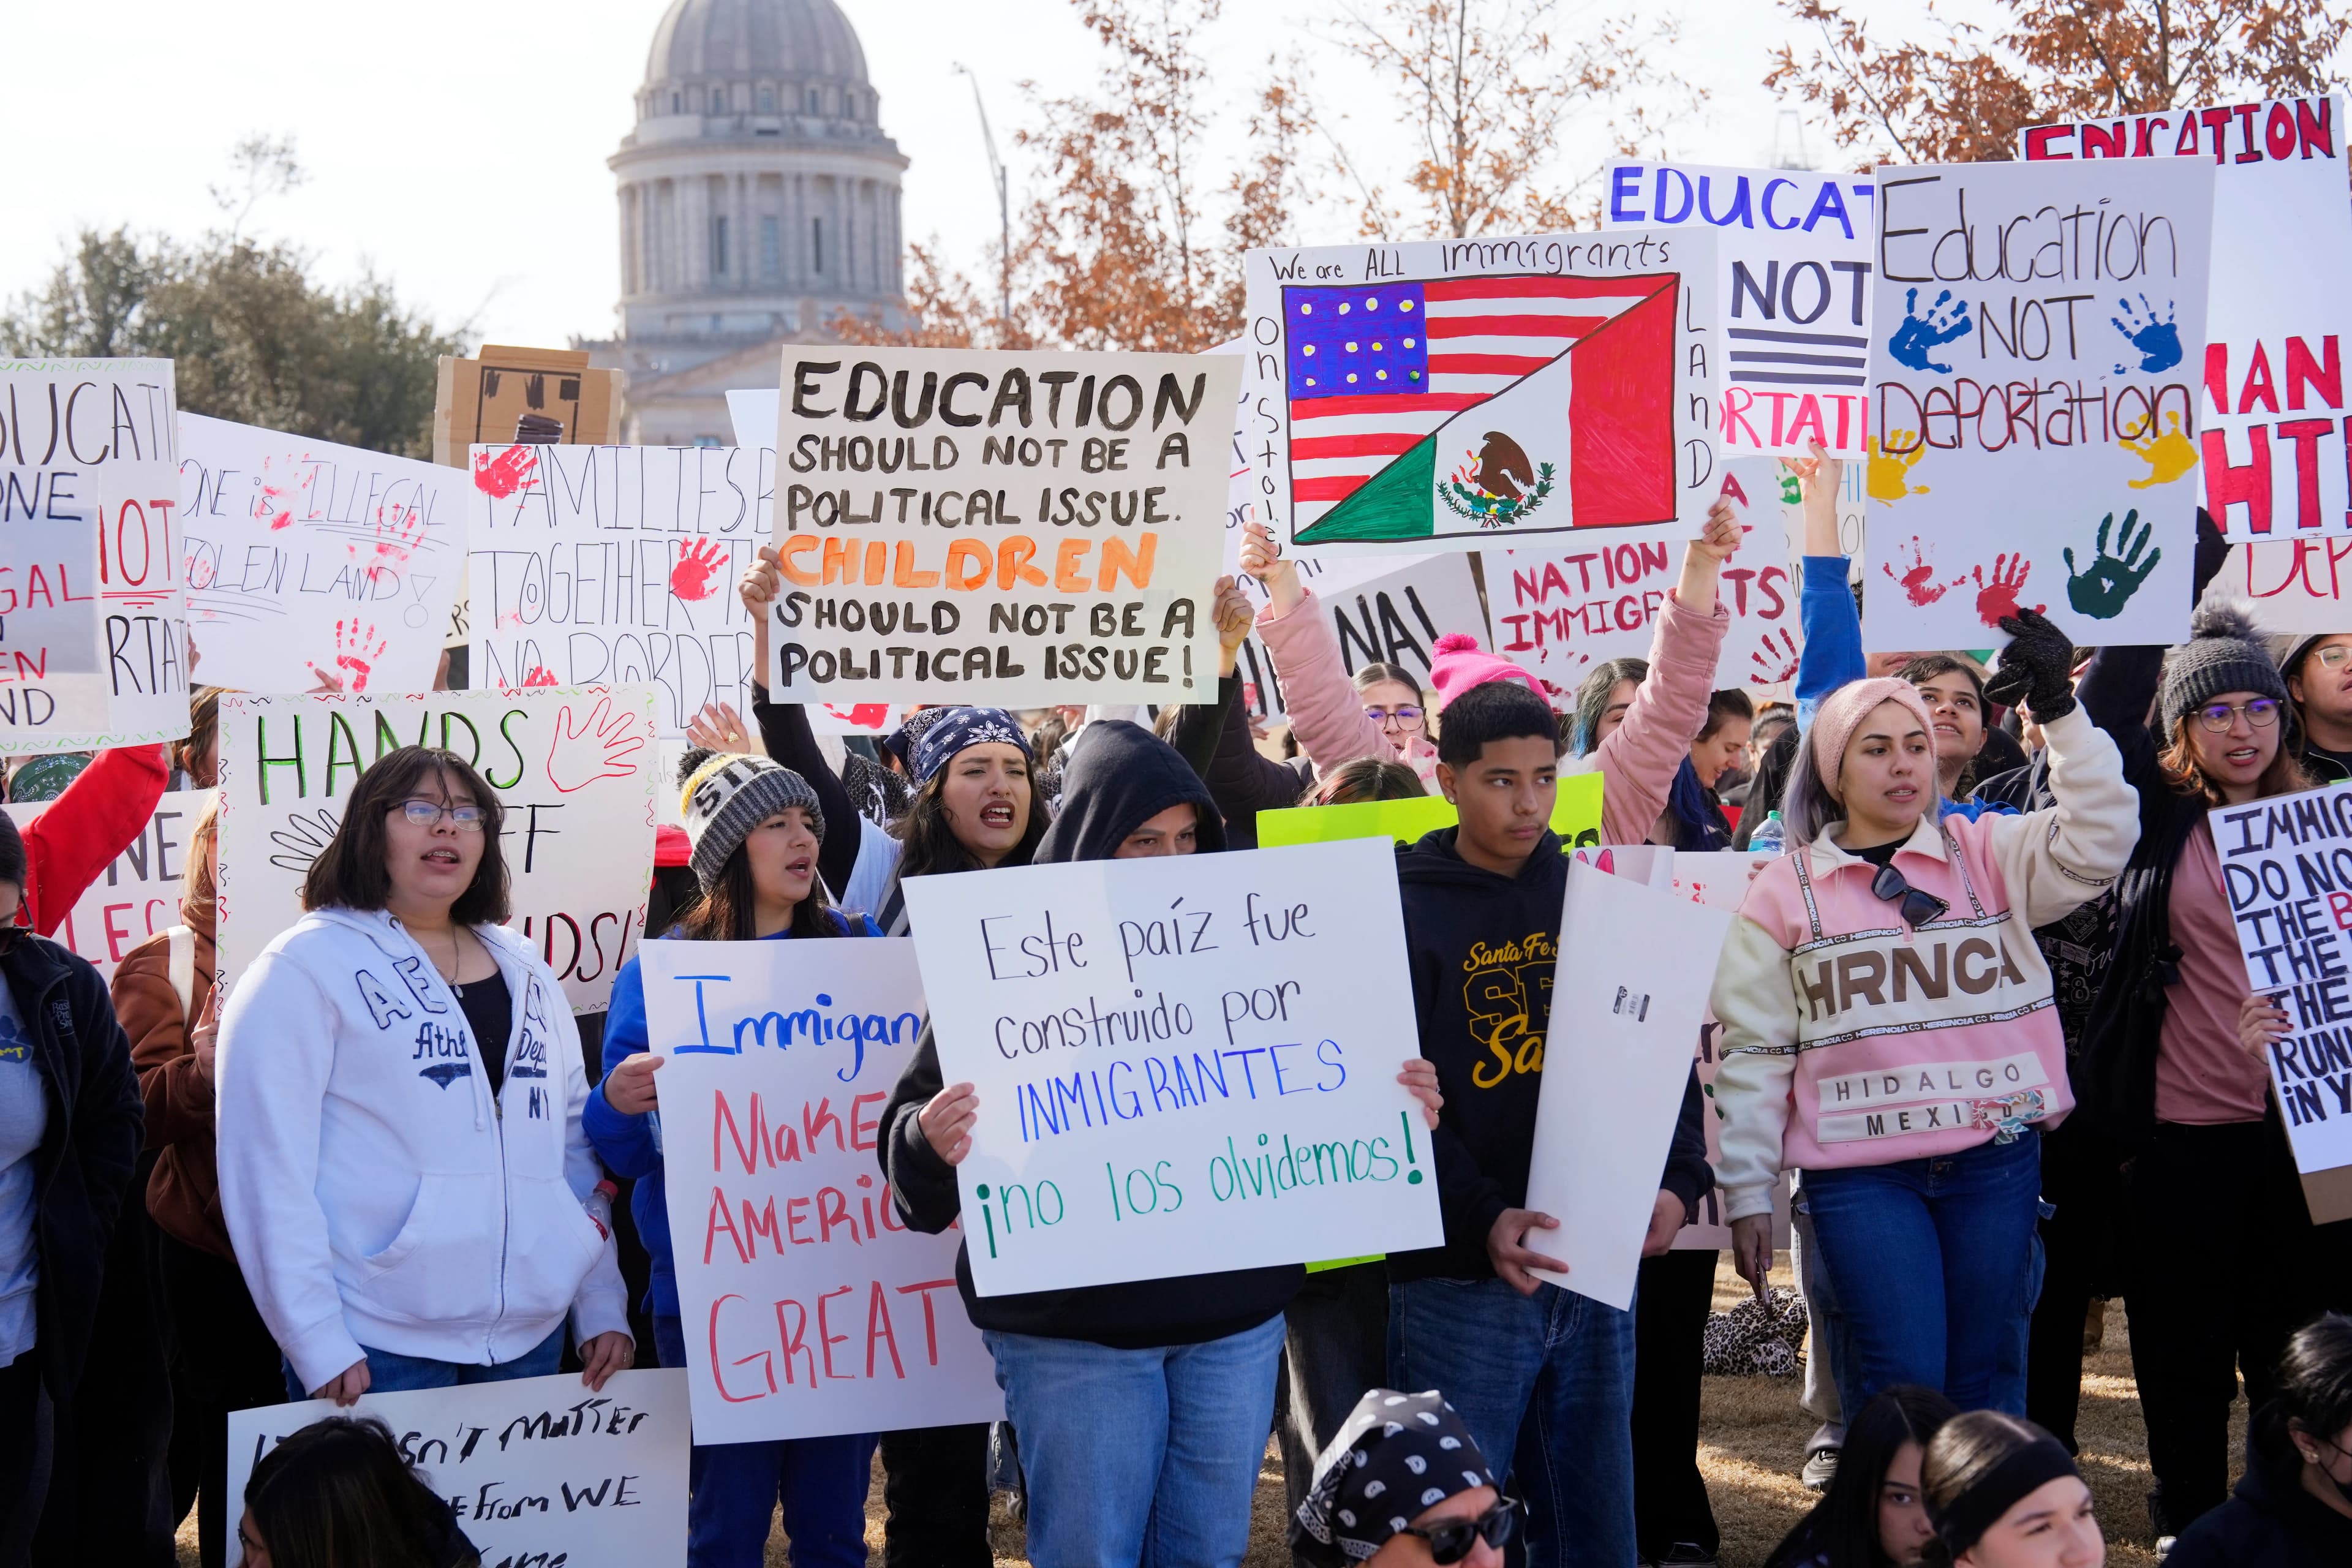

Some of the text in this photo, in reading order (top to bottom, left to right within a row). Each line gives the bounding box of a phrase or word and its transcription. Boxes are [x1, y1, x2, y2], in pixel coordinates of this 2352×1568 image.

[2026, 97, 2337, 165] EDUCATION
[1269, 235, 1670, 282] We are ALL Immigrants
[1881, 176, 2177, 284] Education
[1731, 260, 1872, 326] NOT
[1979, 295, 2095, 361] NOT
[792, 361, 1207, 432] EDUCATION
[789, 434, 960, 473] SHOULD
[982, 435, 1068, 468] NOT
[1081, 439, 1130, 473] BE
[1156, 432, 1190, 470] A
[0, 472, 81, 521] NE
[298, 461, 446, 527] ILLEGAL
[486, 445, 746, 535] FAMILIES
[788, 484, 1022, 531] POLITICAL
[1039, 486, 1182, 527] ISSUE.
[470, 539, 695, 630] TOGETHER
[778, 533, 1158, 593] CHILDREN
[1513, 541, 1668, 608] NATION
[777, 592, 1196, 638] SHOULD NOT BE A
[780, 642, 1025, 687] POLITICAL
[1044, 643, 1194, 690] ISSUE!
[2223, 859, 2290, 911] DO
[980, 910, 1088, 981] Este
[1243, 892, 1317, 948] fue
[1849, 927, 1903, 941] HERENCIA
[2237, 895, 2329, 947] THE
[1463, 940, 1523, 972] Santa
[1523, 932, 1550, 960] Fe
[2247, 935, 2348, 988] THE
[995, 979, 1302, 1060] construido por
[1855, 1024, 1908, 1039] HERENCIA
[1922, 1017, 1975, 1030] HERENCIA
[1017, 1038, 1347, 1143] INMIGRANTES
[1836, 1063, 2019, 1102] HIDALGO
[1106, 1159, 1183, 1222] los
[1210, 1110, 1423, 1203] olvidemos!
[709, 1280, 957, 1404] GREAT
[560, 1476, 641, 1513] WE
